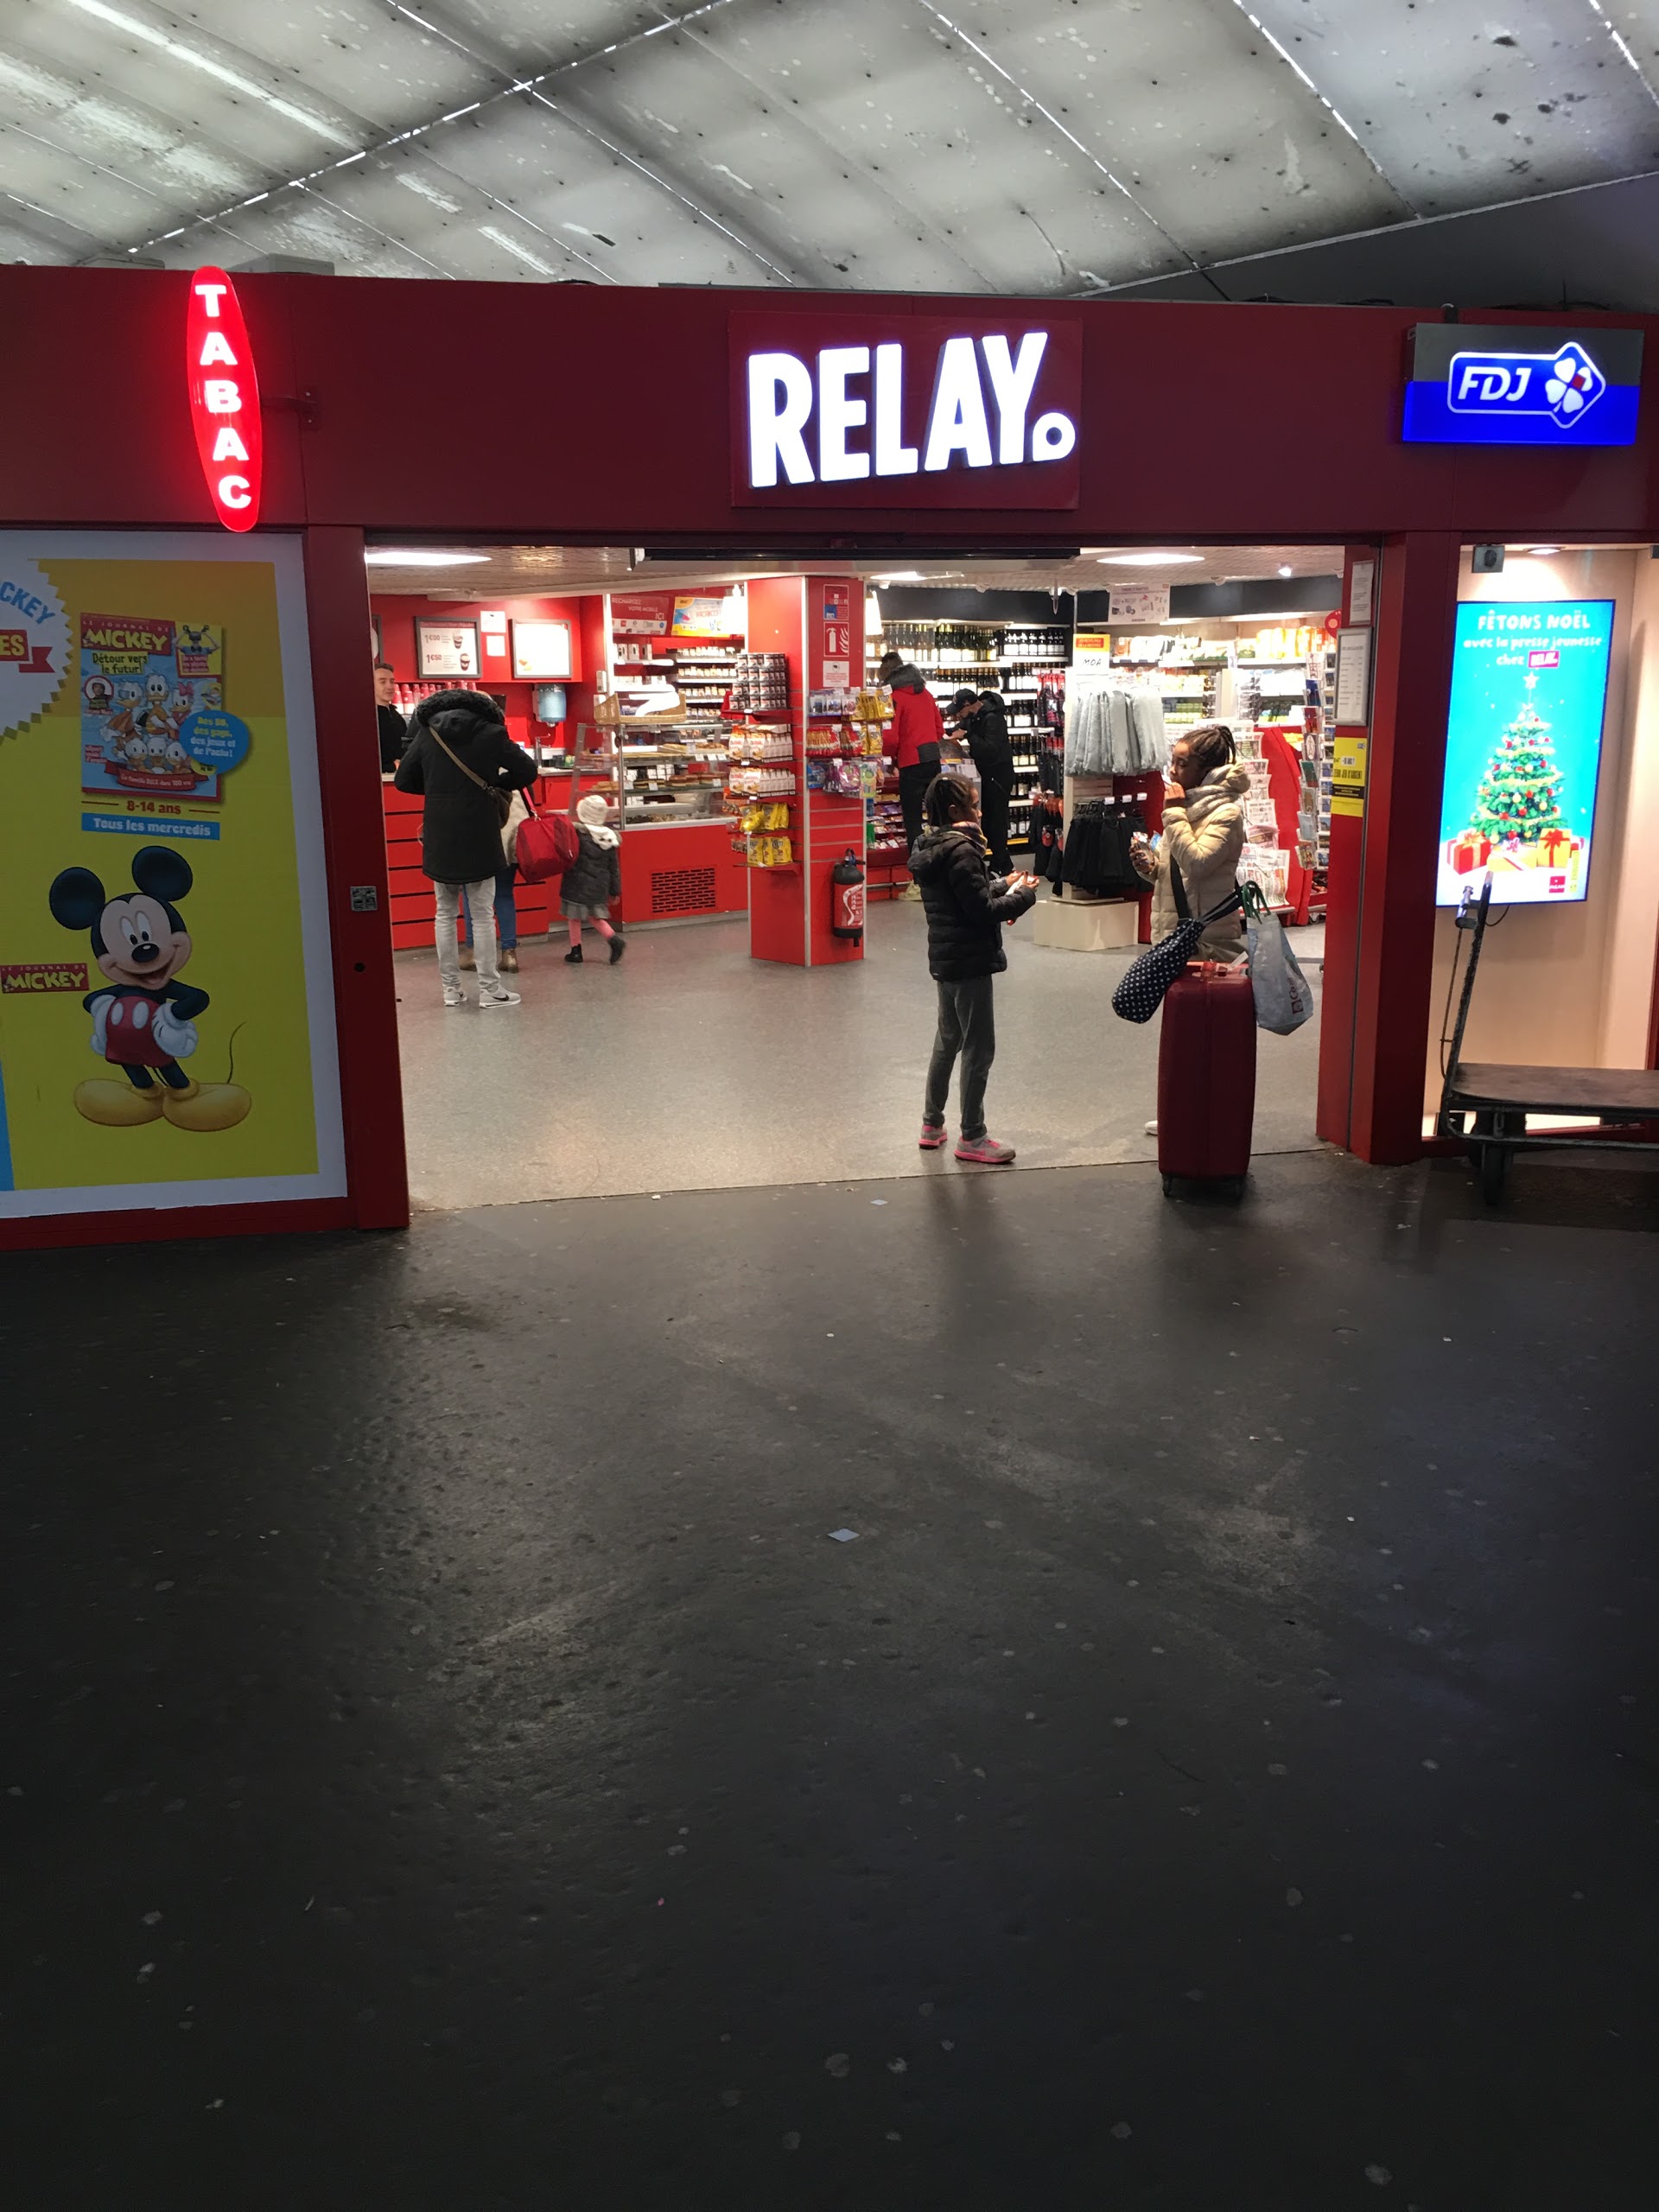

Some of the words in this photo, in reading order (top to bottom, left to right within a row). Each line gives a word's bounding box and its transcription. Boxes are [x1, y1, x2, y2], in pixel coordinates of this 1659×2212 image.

[1458, 366, 1531, 402] FDJ
[195, 284, 251, 509] TABAC
[1478, 609, 1541, 630] FÊTONS
[1546, 609, 1591, 630] NOËL
[87, 628, 168, 651] MICKEY
[1463, 637, 1494, 648] avec
[1496, 636, 1510, 648] la
[1510, 637, 1550, 652] presse
[1550, 635, 1603, 651] jeunesse
[92, 652, 124, 664] Détour
[128, 654, 148, 664] vers
[1496, 653, 1525, 665] chez
[102, 664, 109, 674] le
[207, 737, 226, 747] jeux
[194, 747, 205, 755] de
[127, 800, 155, 812] 8-14
[158, 804, 181, 815] ans
[93, 817, 124, 830] Tous
[126, 819, 144, 831] les
[148, 822, 211, 836] mercredis
[6, 971, 85, 989] MICKEY
